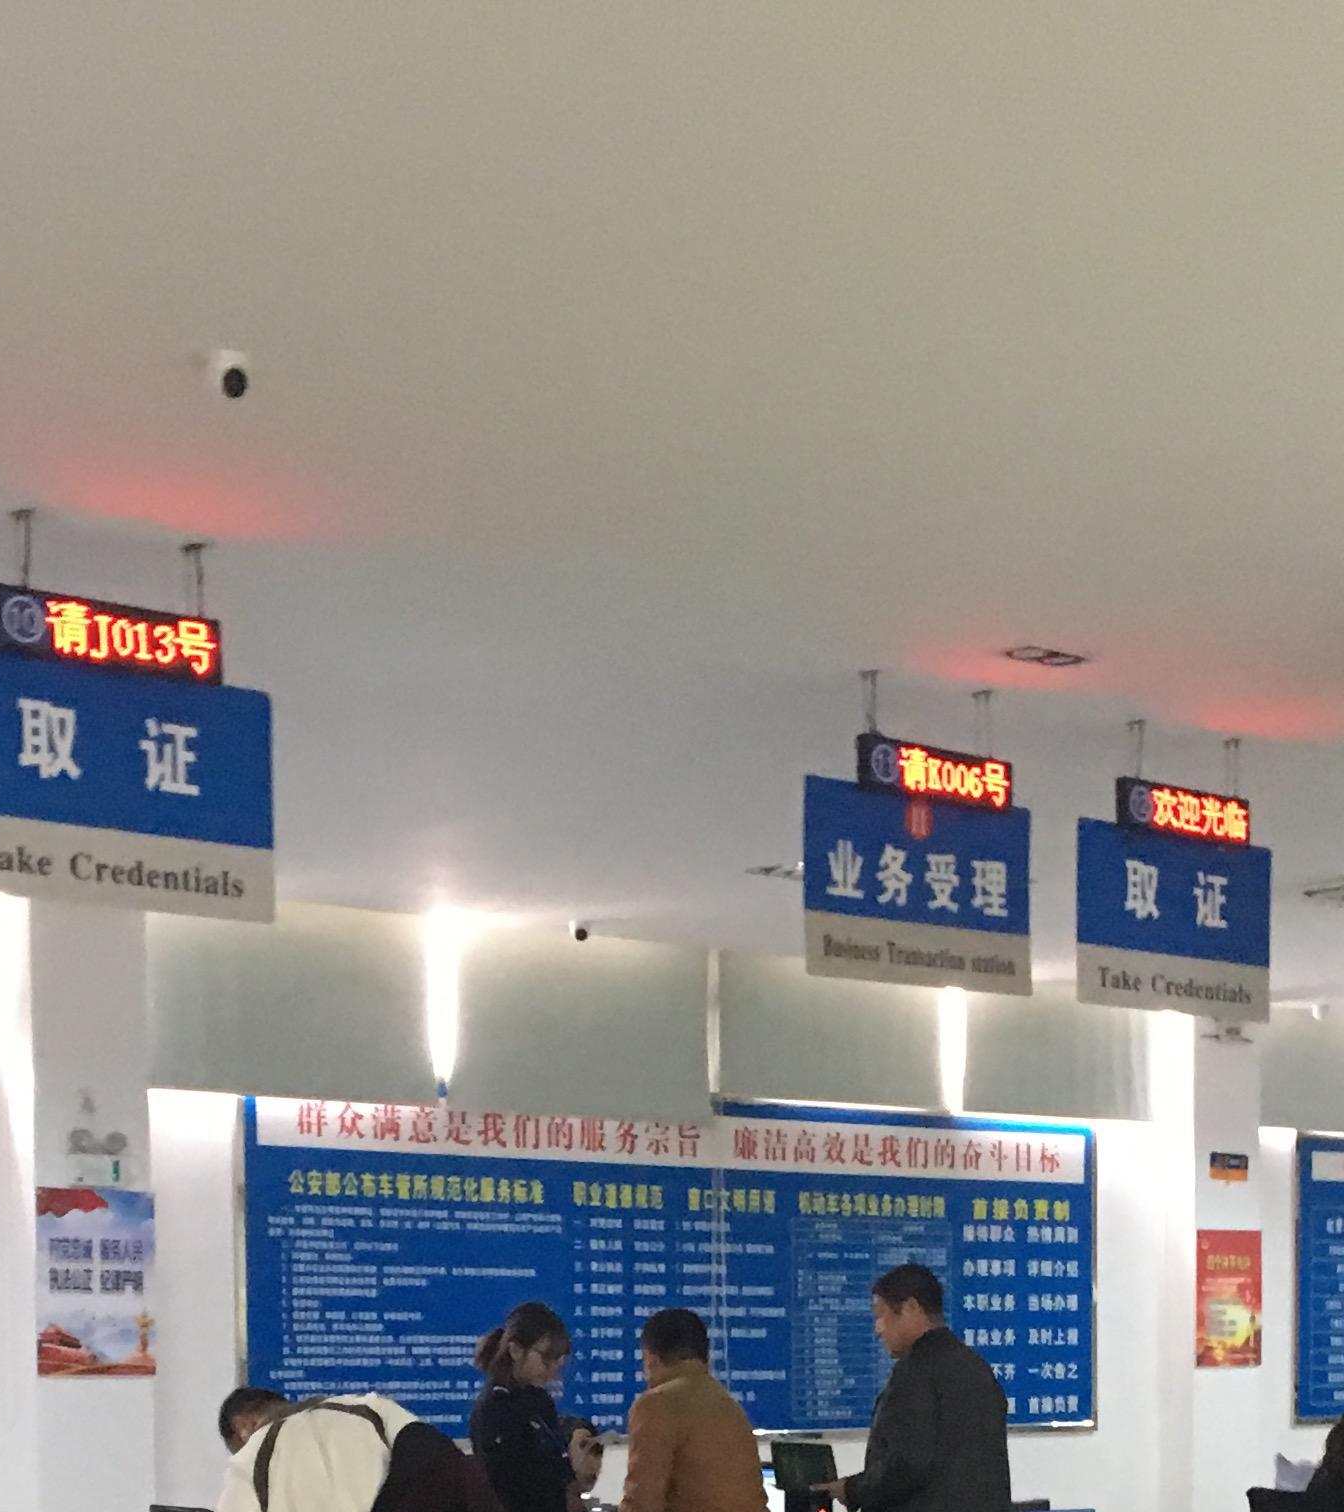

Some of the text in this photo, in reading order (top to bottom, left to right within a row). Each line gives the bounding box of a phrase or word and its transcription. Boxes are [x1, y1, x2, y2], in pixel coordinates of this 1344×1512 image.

[45, 599, 216, 675] 请J013号
[898, 746, 1010, 807] 请K006号
[1151, 787, 1248, 841] 欢迎光临
[69, 850, 245, 899] Credentials
[825, 839, 1009, 918] 业务受理
[1097, 966, 1253, 1005] Take Credentials
[297, 1099, 1062, 1174] 群众满意是我们的服务宗旨 廉洁高效是我们的奋斗目标
